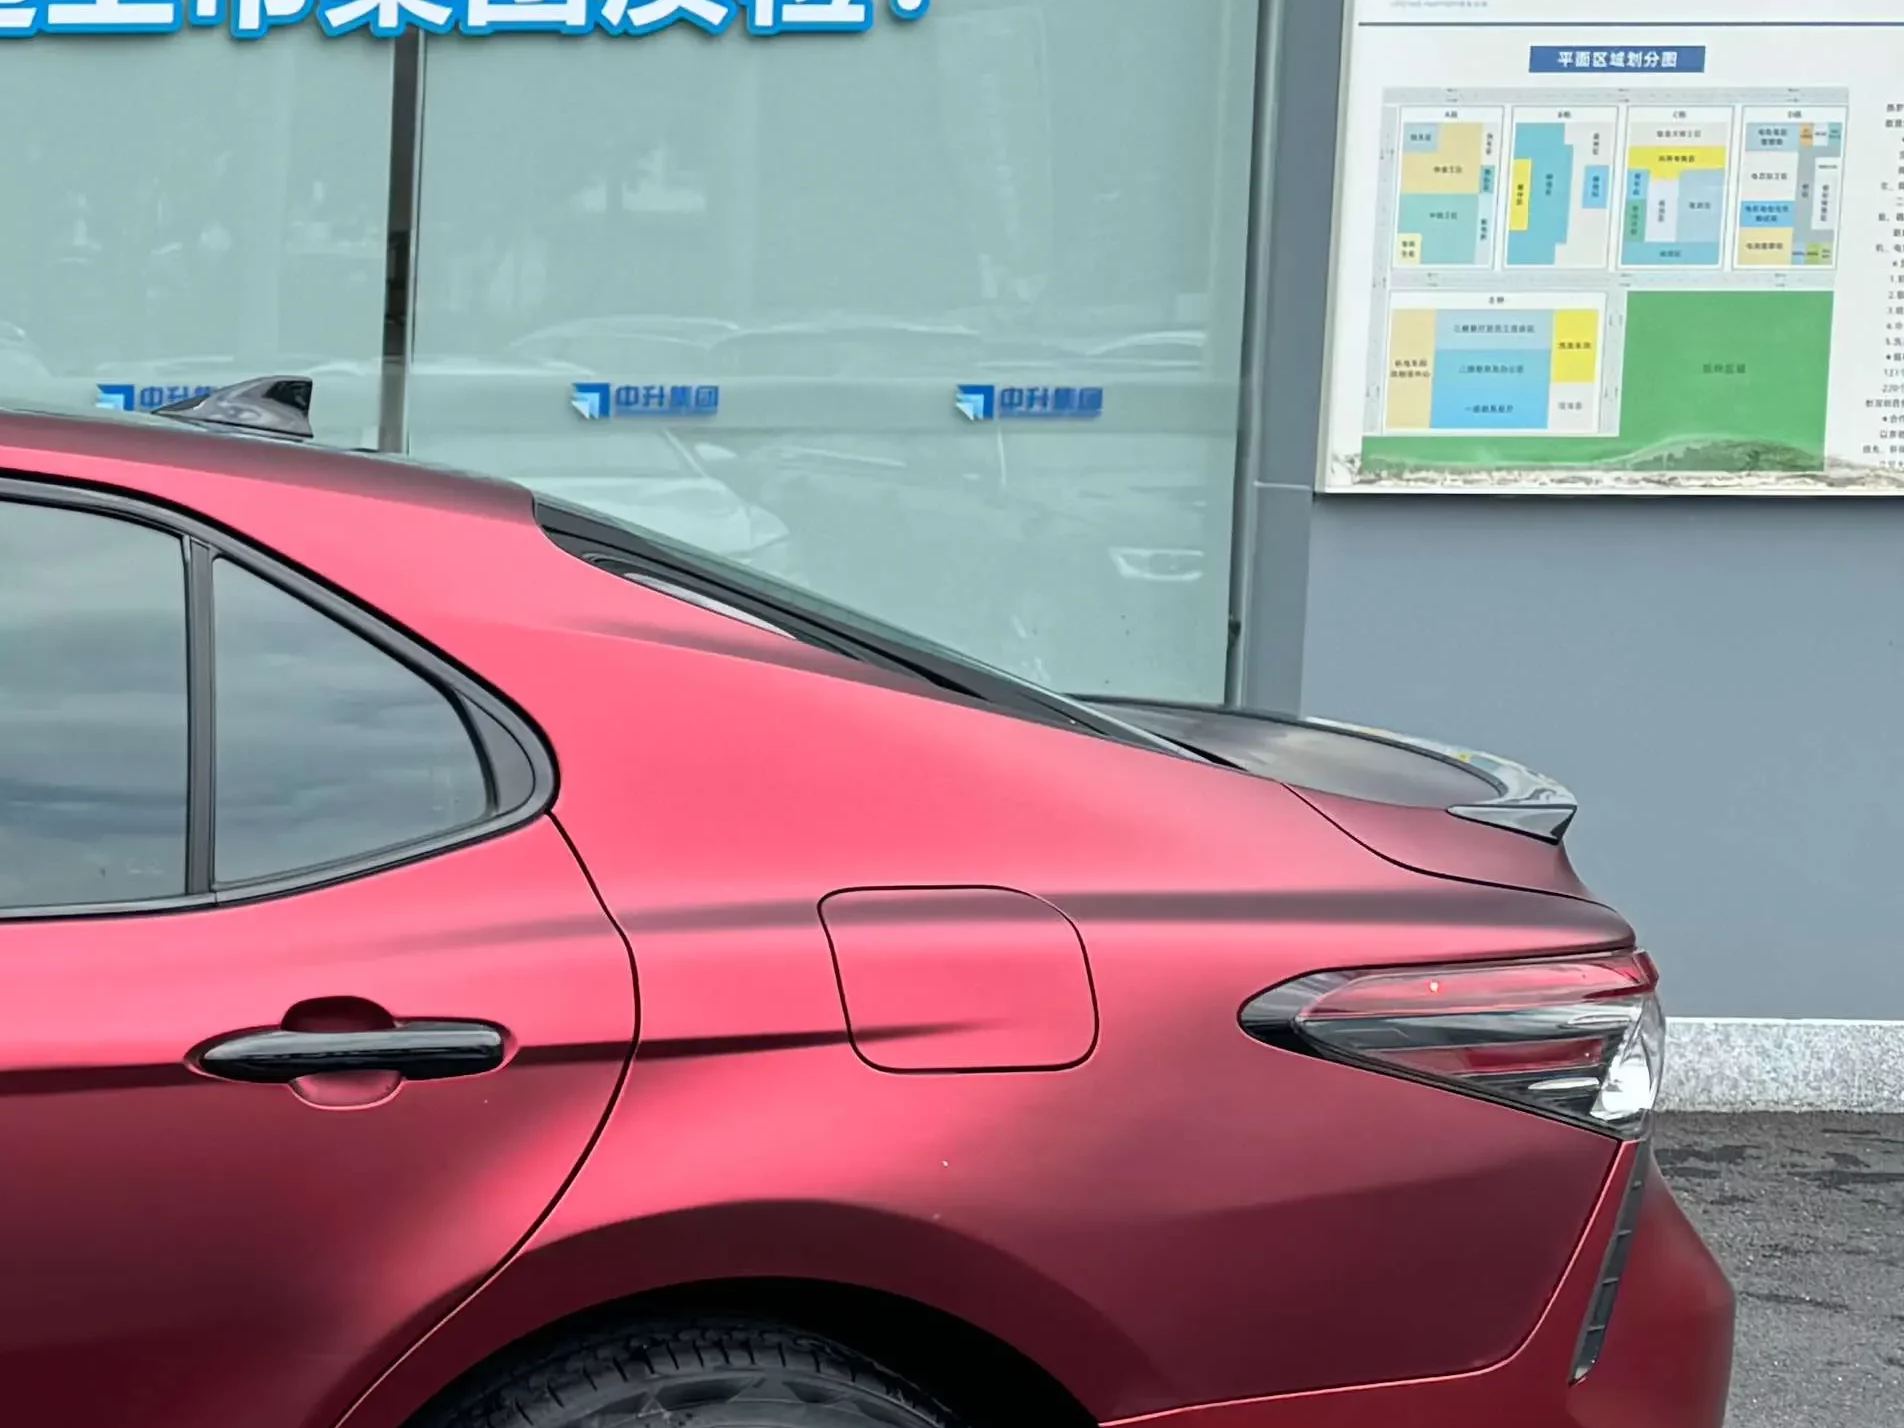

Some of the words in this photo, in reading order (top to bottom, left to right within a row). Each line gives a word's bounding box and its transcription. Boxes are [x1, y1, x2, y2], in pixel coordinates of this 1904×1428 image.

[1557, 51, 1678, 68] 平面区域划分图
[615, 384, 719, 408] 中升集团
[1001, 386, 1103, 410] 中升集团
